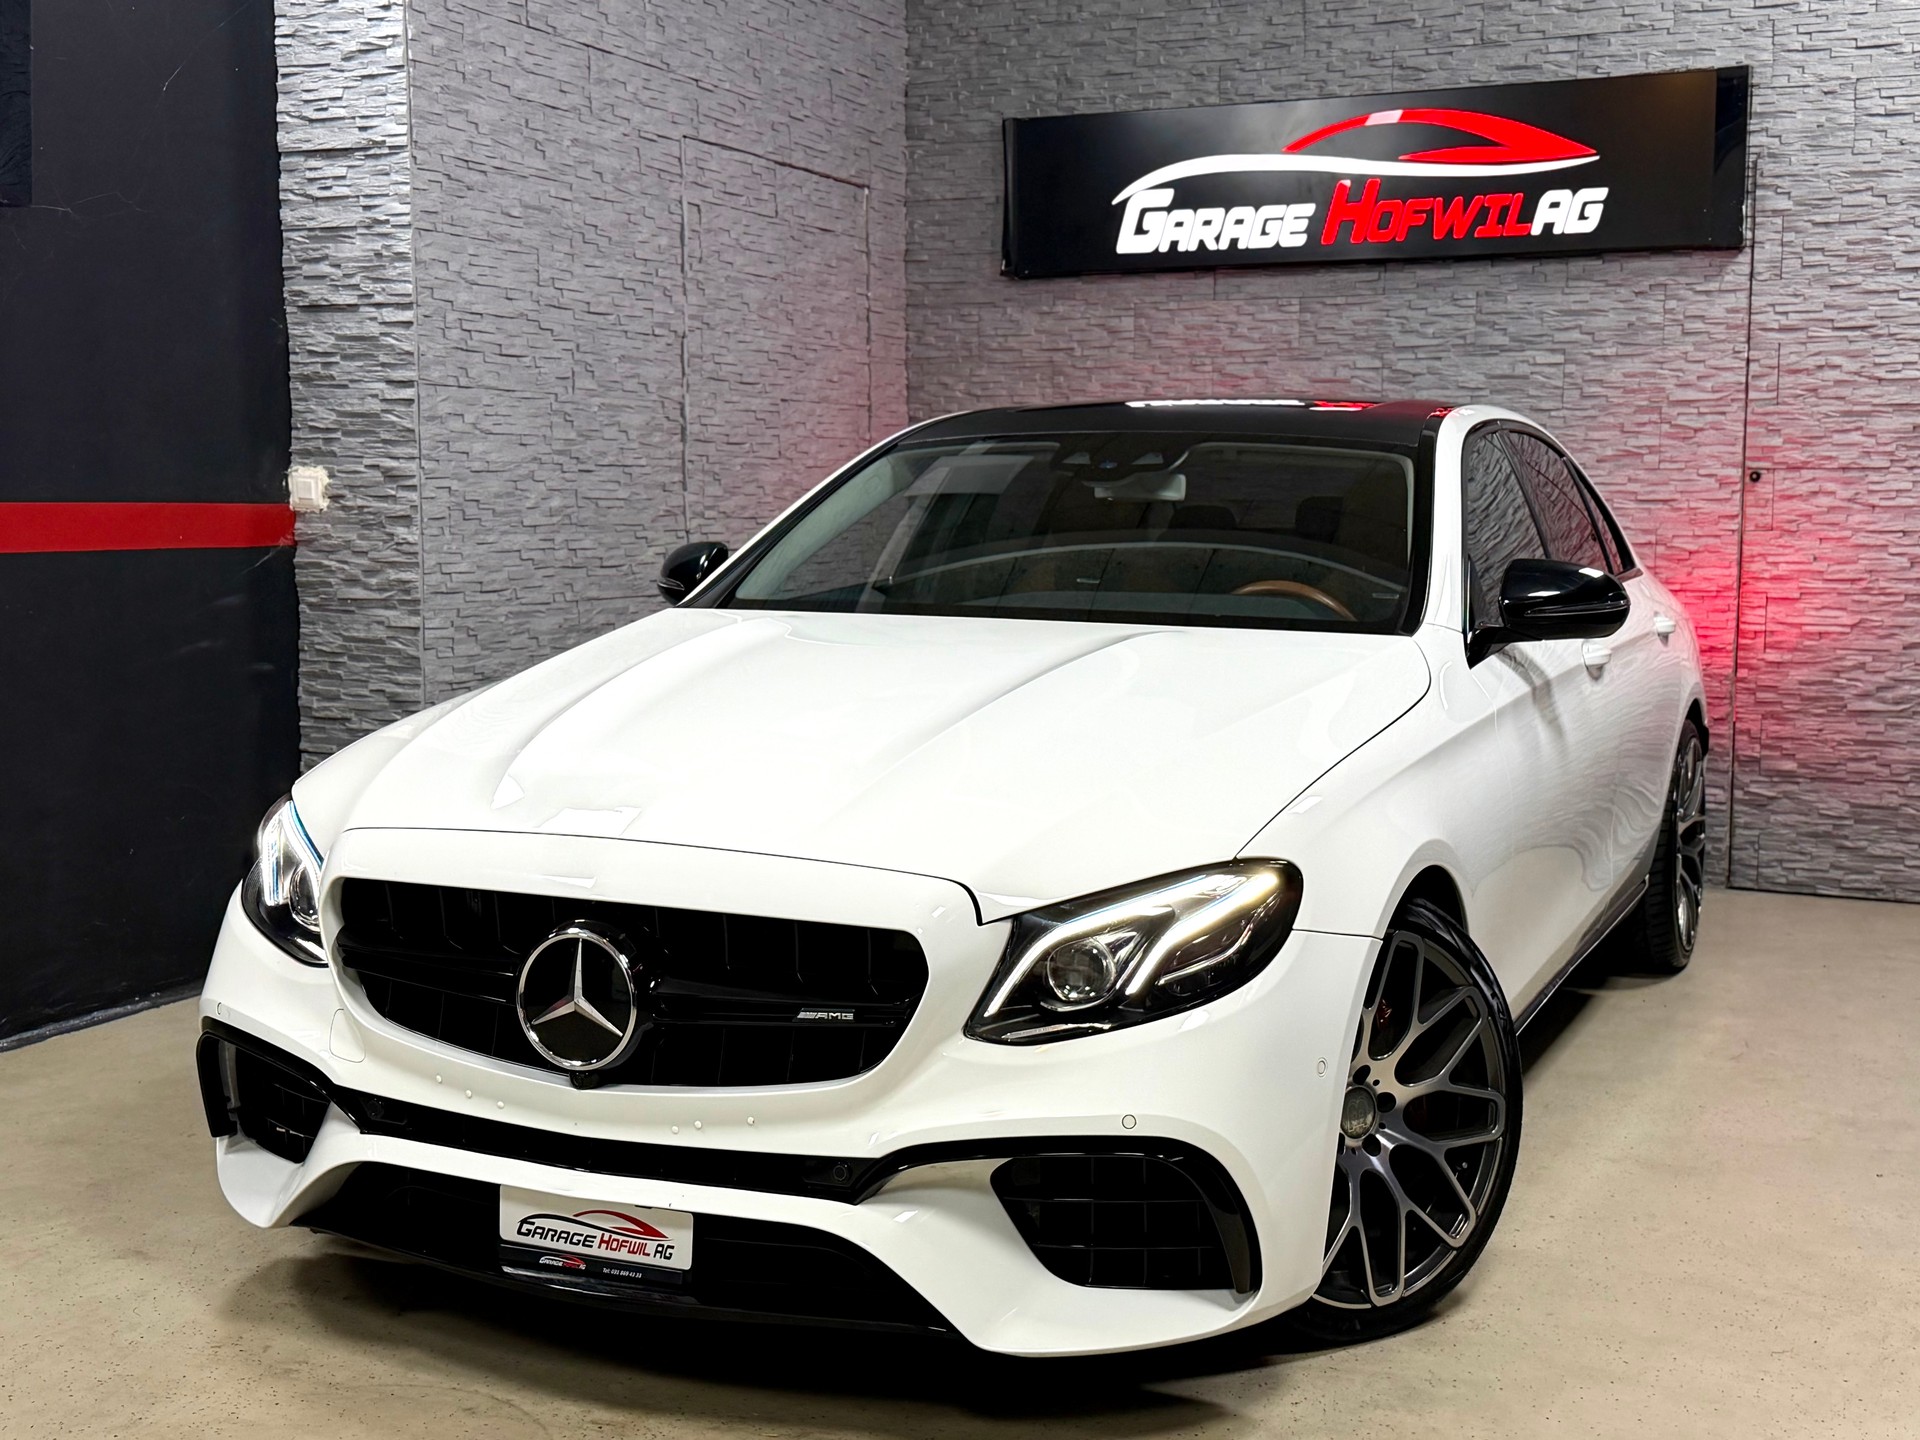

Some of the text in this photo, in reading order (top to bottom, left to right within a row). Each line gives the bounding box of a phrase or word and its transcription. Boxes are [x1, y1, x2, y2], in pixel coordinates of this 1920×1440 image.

[1116, 188, 1316, 255] GARAGE
[814, 1012, 854, 1020] AMG
[516, 1220, 675, 1260] GARAGE HOFWIL AG
